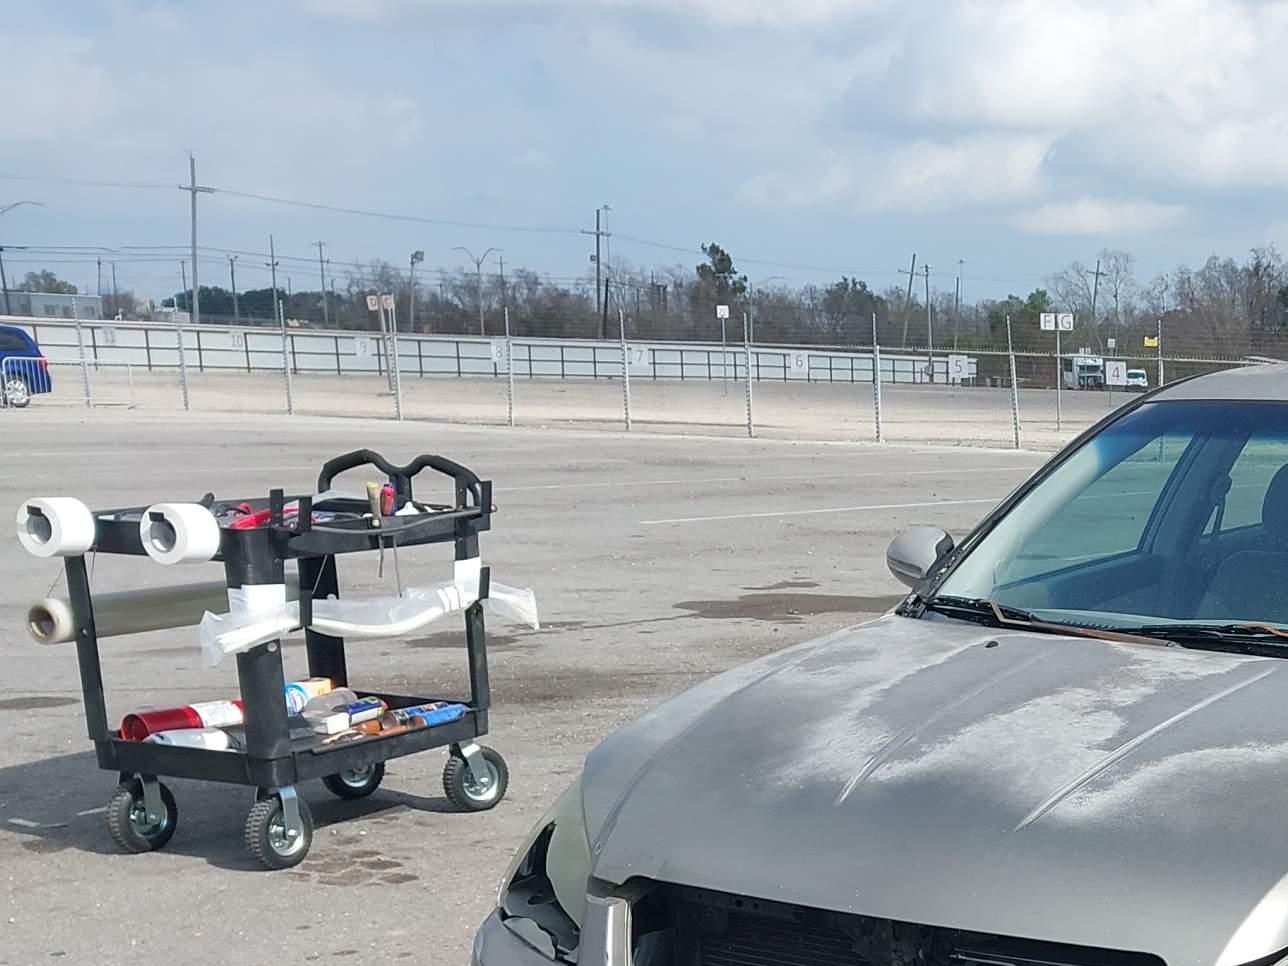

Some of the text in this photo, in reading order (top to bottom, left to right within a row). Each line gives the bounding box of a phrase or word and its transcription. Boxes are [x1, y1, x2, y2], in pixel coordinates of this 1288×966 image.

[1043, 315, 1053, 329] F
[1060, 315, 1072, 330] G
[231, 334, 243, 347] 10
[359, 340, 367, 353] 9
[495, 346, 502, 357] 8
[636, 349, 643, 362] 7
[795, 355, 804, 368] 6
[954, 359, 963, 374] 5
[1111, 367, 1121, 380] 4
